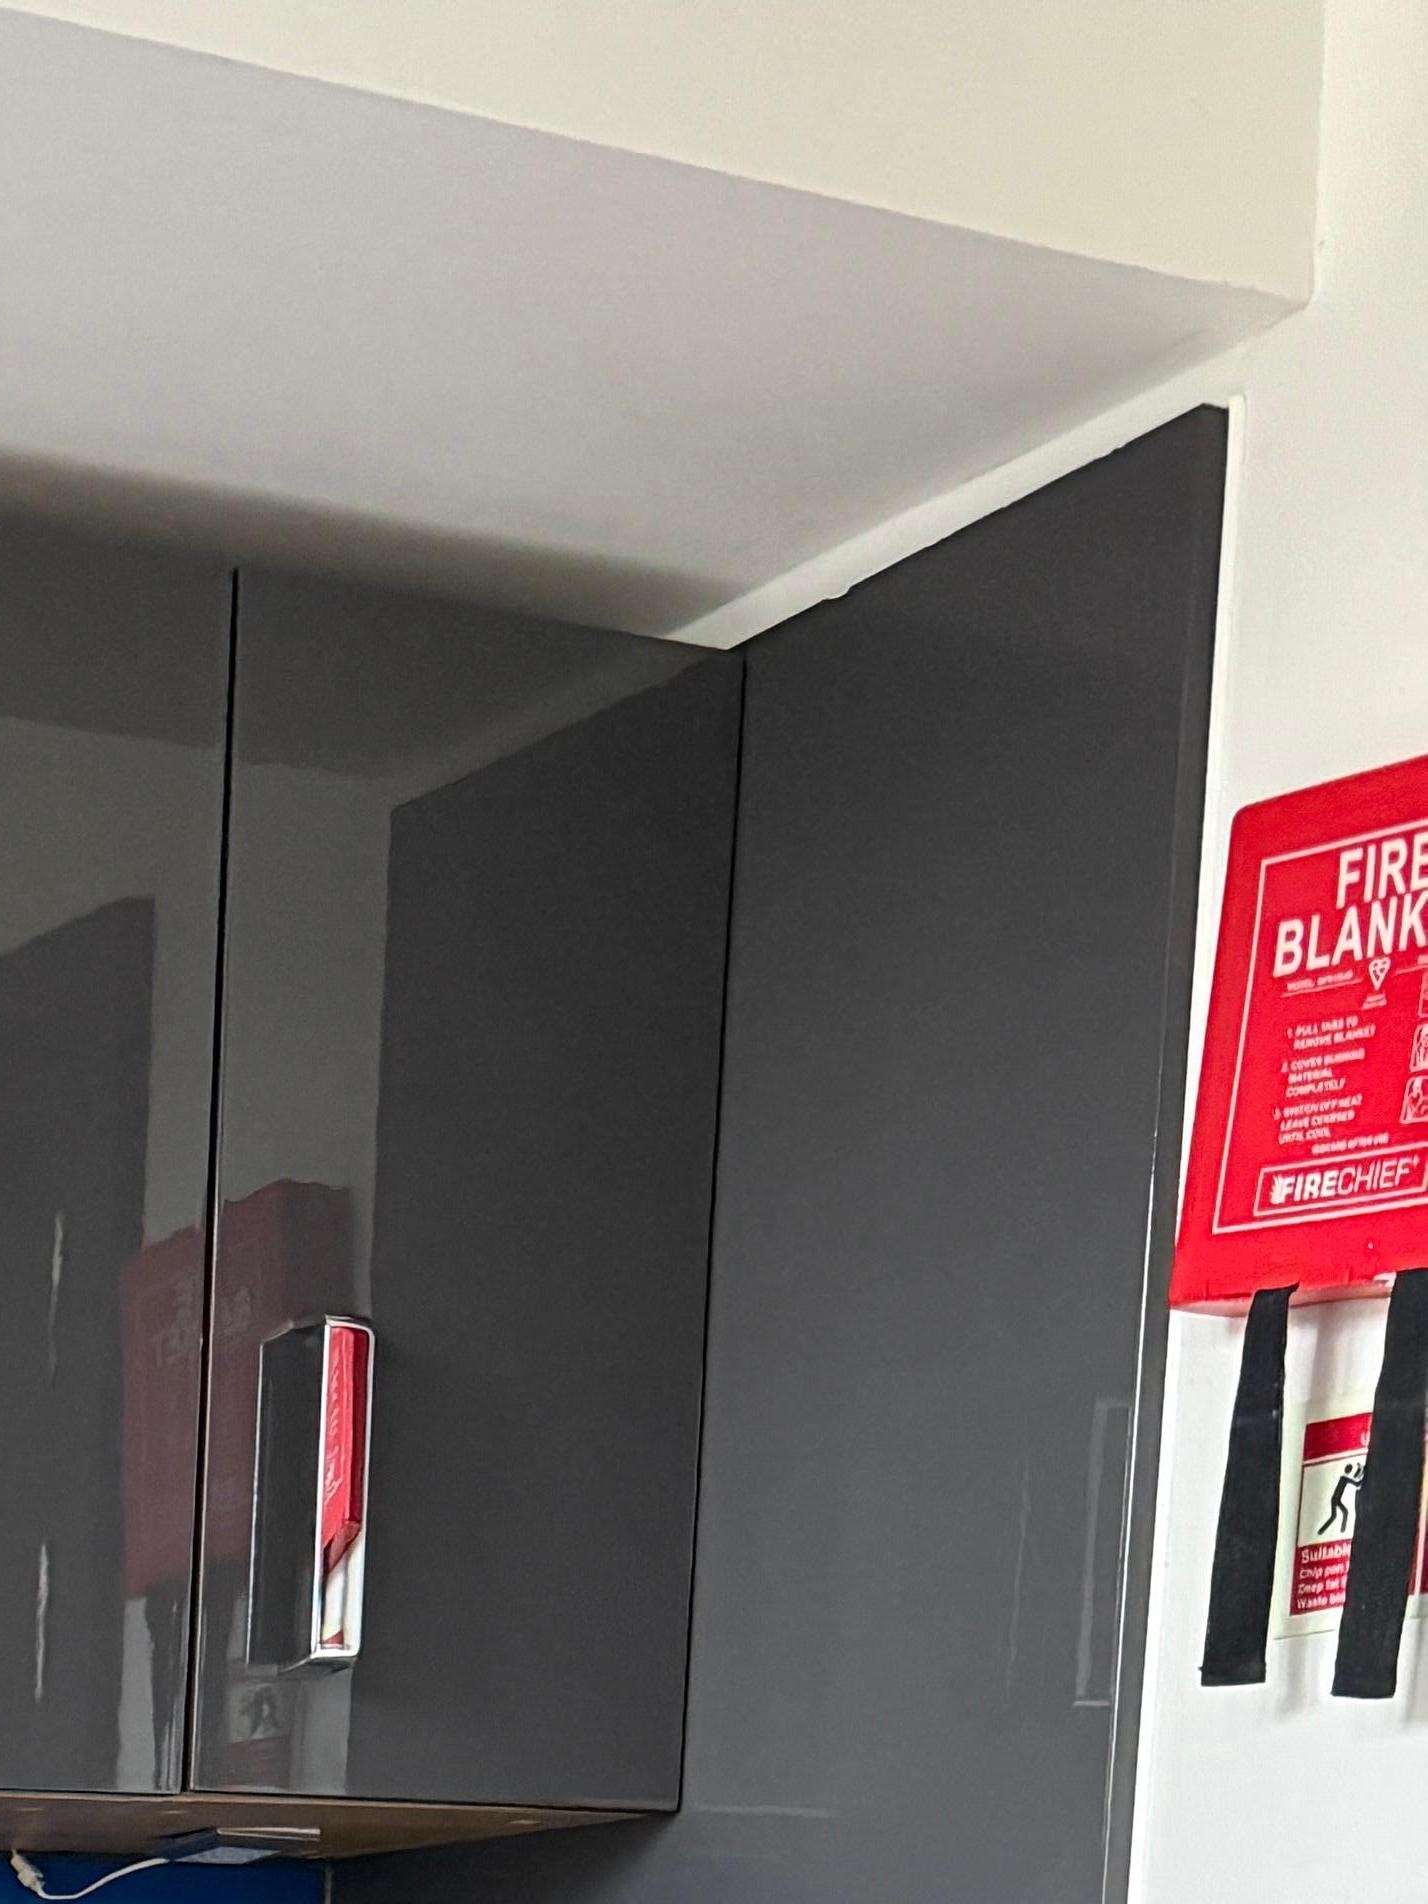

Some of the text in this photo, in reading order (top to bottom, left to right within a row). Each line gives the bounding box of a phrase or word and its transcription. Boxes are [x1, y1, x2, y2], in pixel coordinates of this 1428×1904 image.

[1336, 832, 1428, 909] FIRE
[1272, 890, 1428, 978] BLANK
[1278, 1157, 1413, 1203] FIRECHIEF
